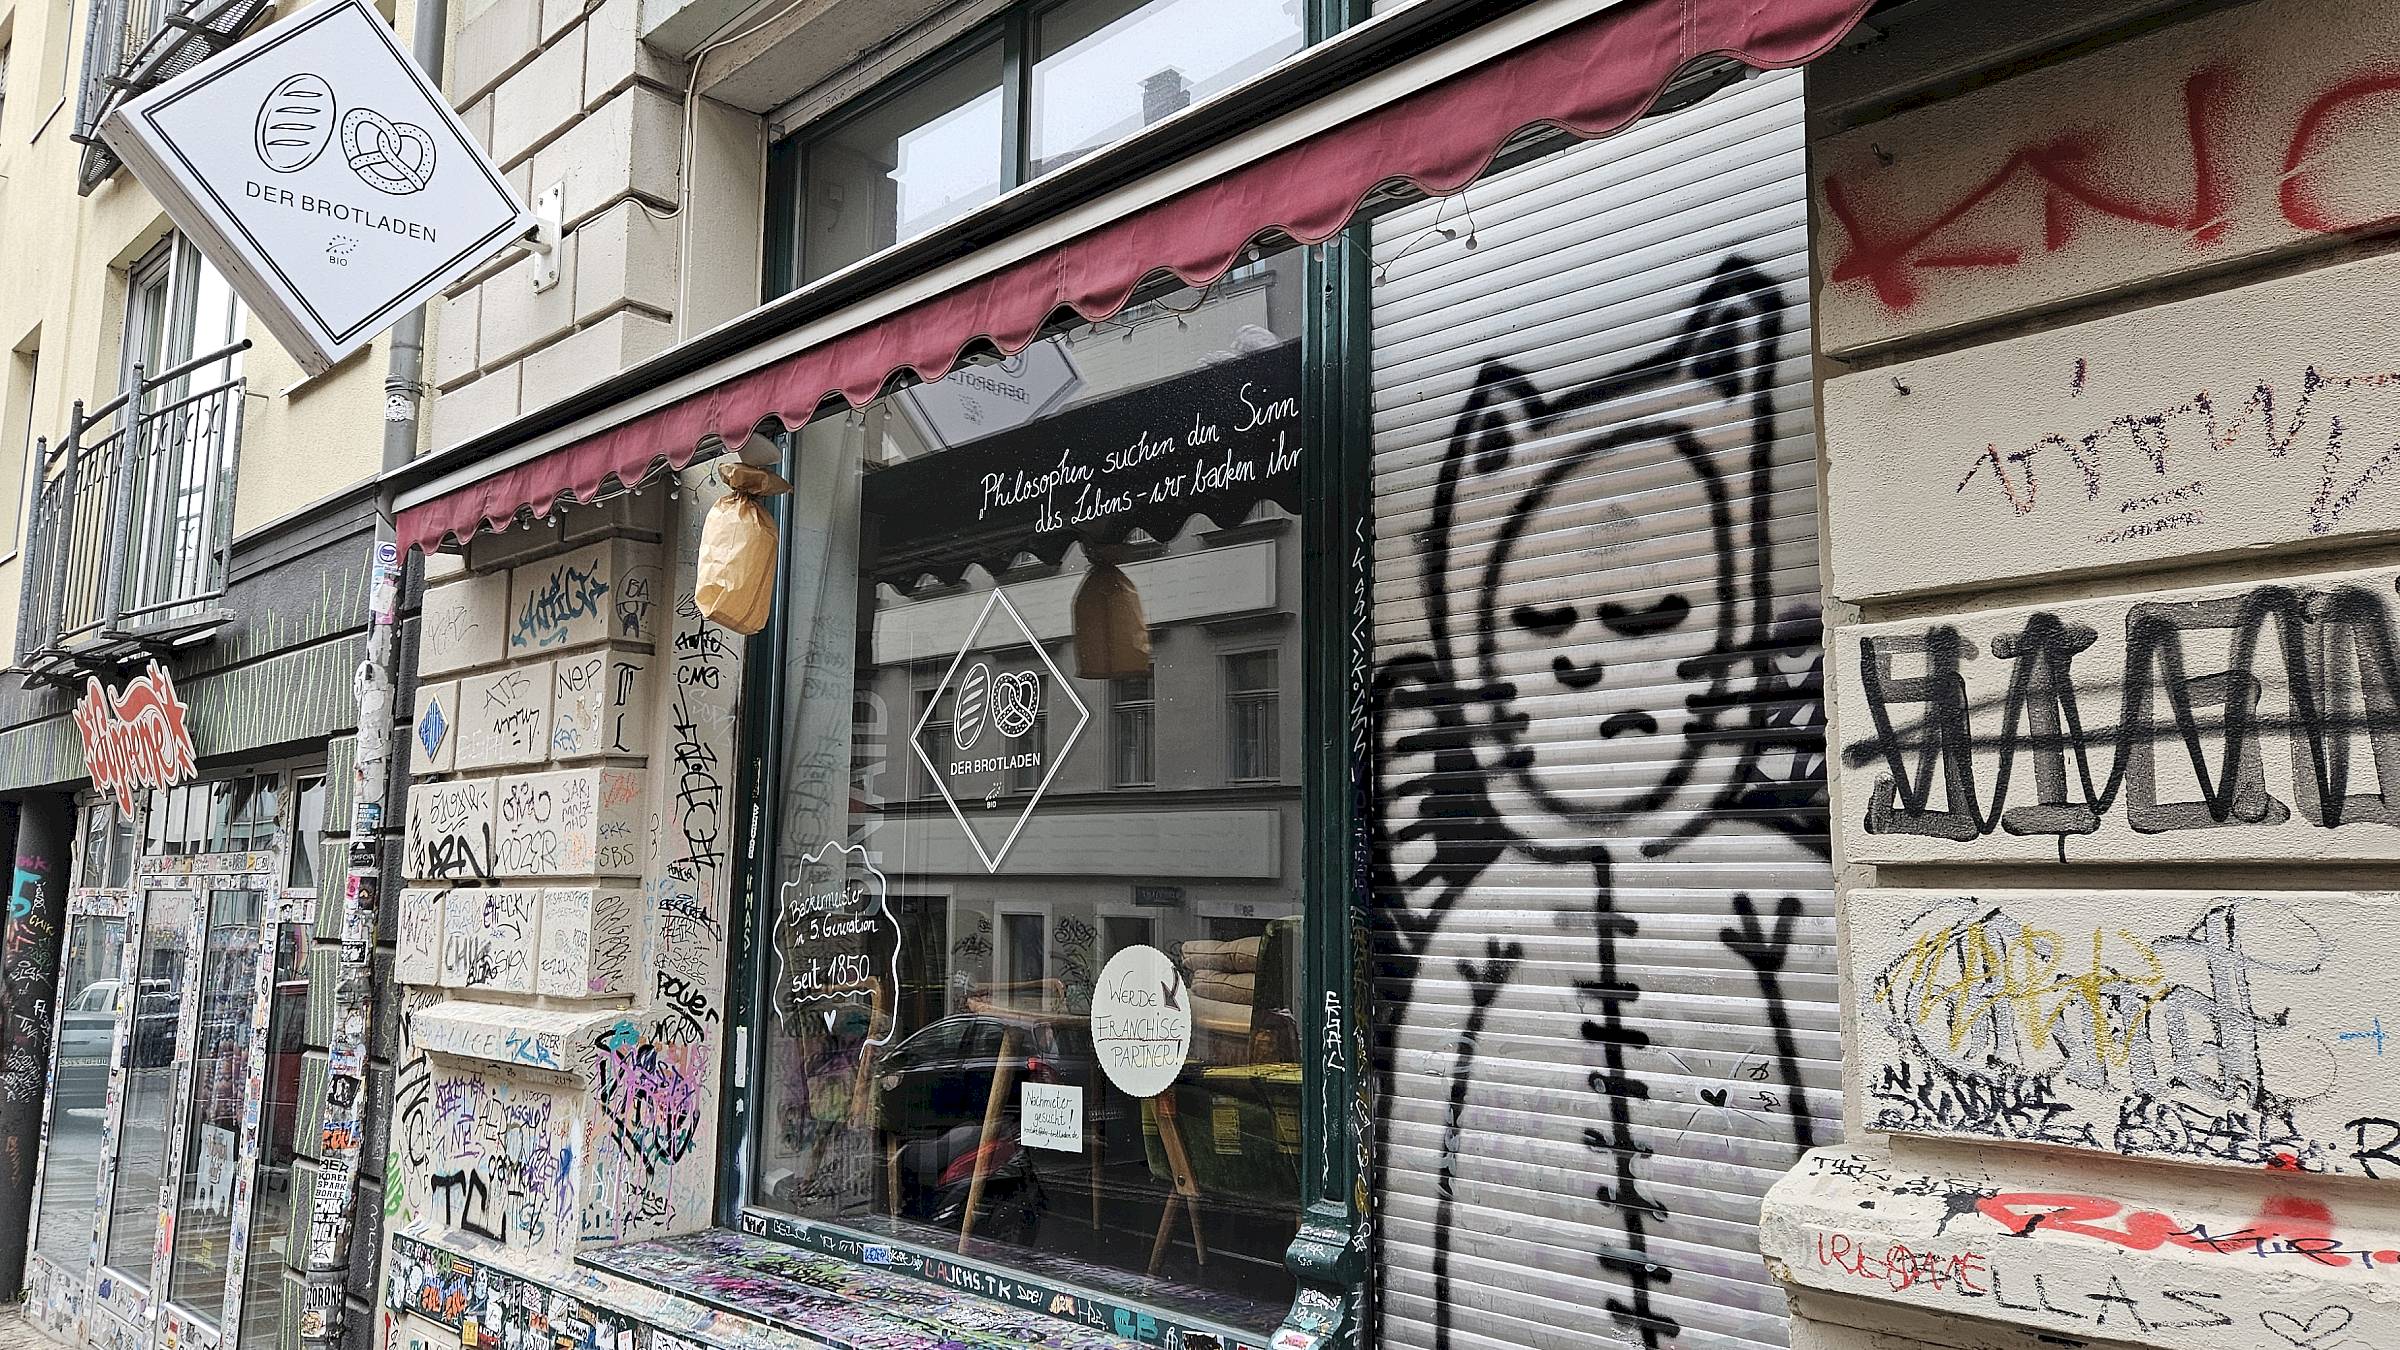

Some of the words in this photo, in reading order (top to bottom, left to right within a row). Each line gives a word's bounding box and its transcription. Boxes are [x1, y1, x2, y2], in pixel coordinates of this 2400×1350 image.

[246, 180, 294, 208] DER
[301, 196, 436, 243] BROTLADEN
[329, 254, 348, 267] BIO
[1102, 429, 1175, 474] suchen
[1188, 413, 1220, 445] den
[1234, 382, 1299, 432] Sinn
[1035, 508, 1063, 534] des
[1071, 485, 1132, 524] Lebens
[1149, 474, 1187, 506] wir
[1190, 457, 1255, 496] backen
[950, 758, 972, 776] DER
[974, 752, 1041, 774] BROTLADEN
[986, 800, 997, 809] BIO
[792, 930, 805, 951] in
[809, 919, 820, 940] 5.
[822, 911, 878, 938] Generation
[792, 958, 823, 992] seit
[828, 954, 870, 989] 1850
[1109, 971, 1158, 1008] WERDE
[1110, 1040, 1181, 1069] PARTNER!
